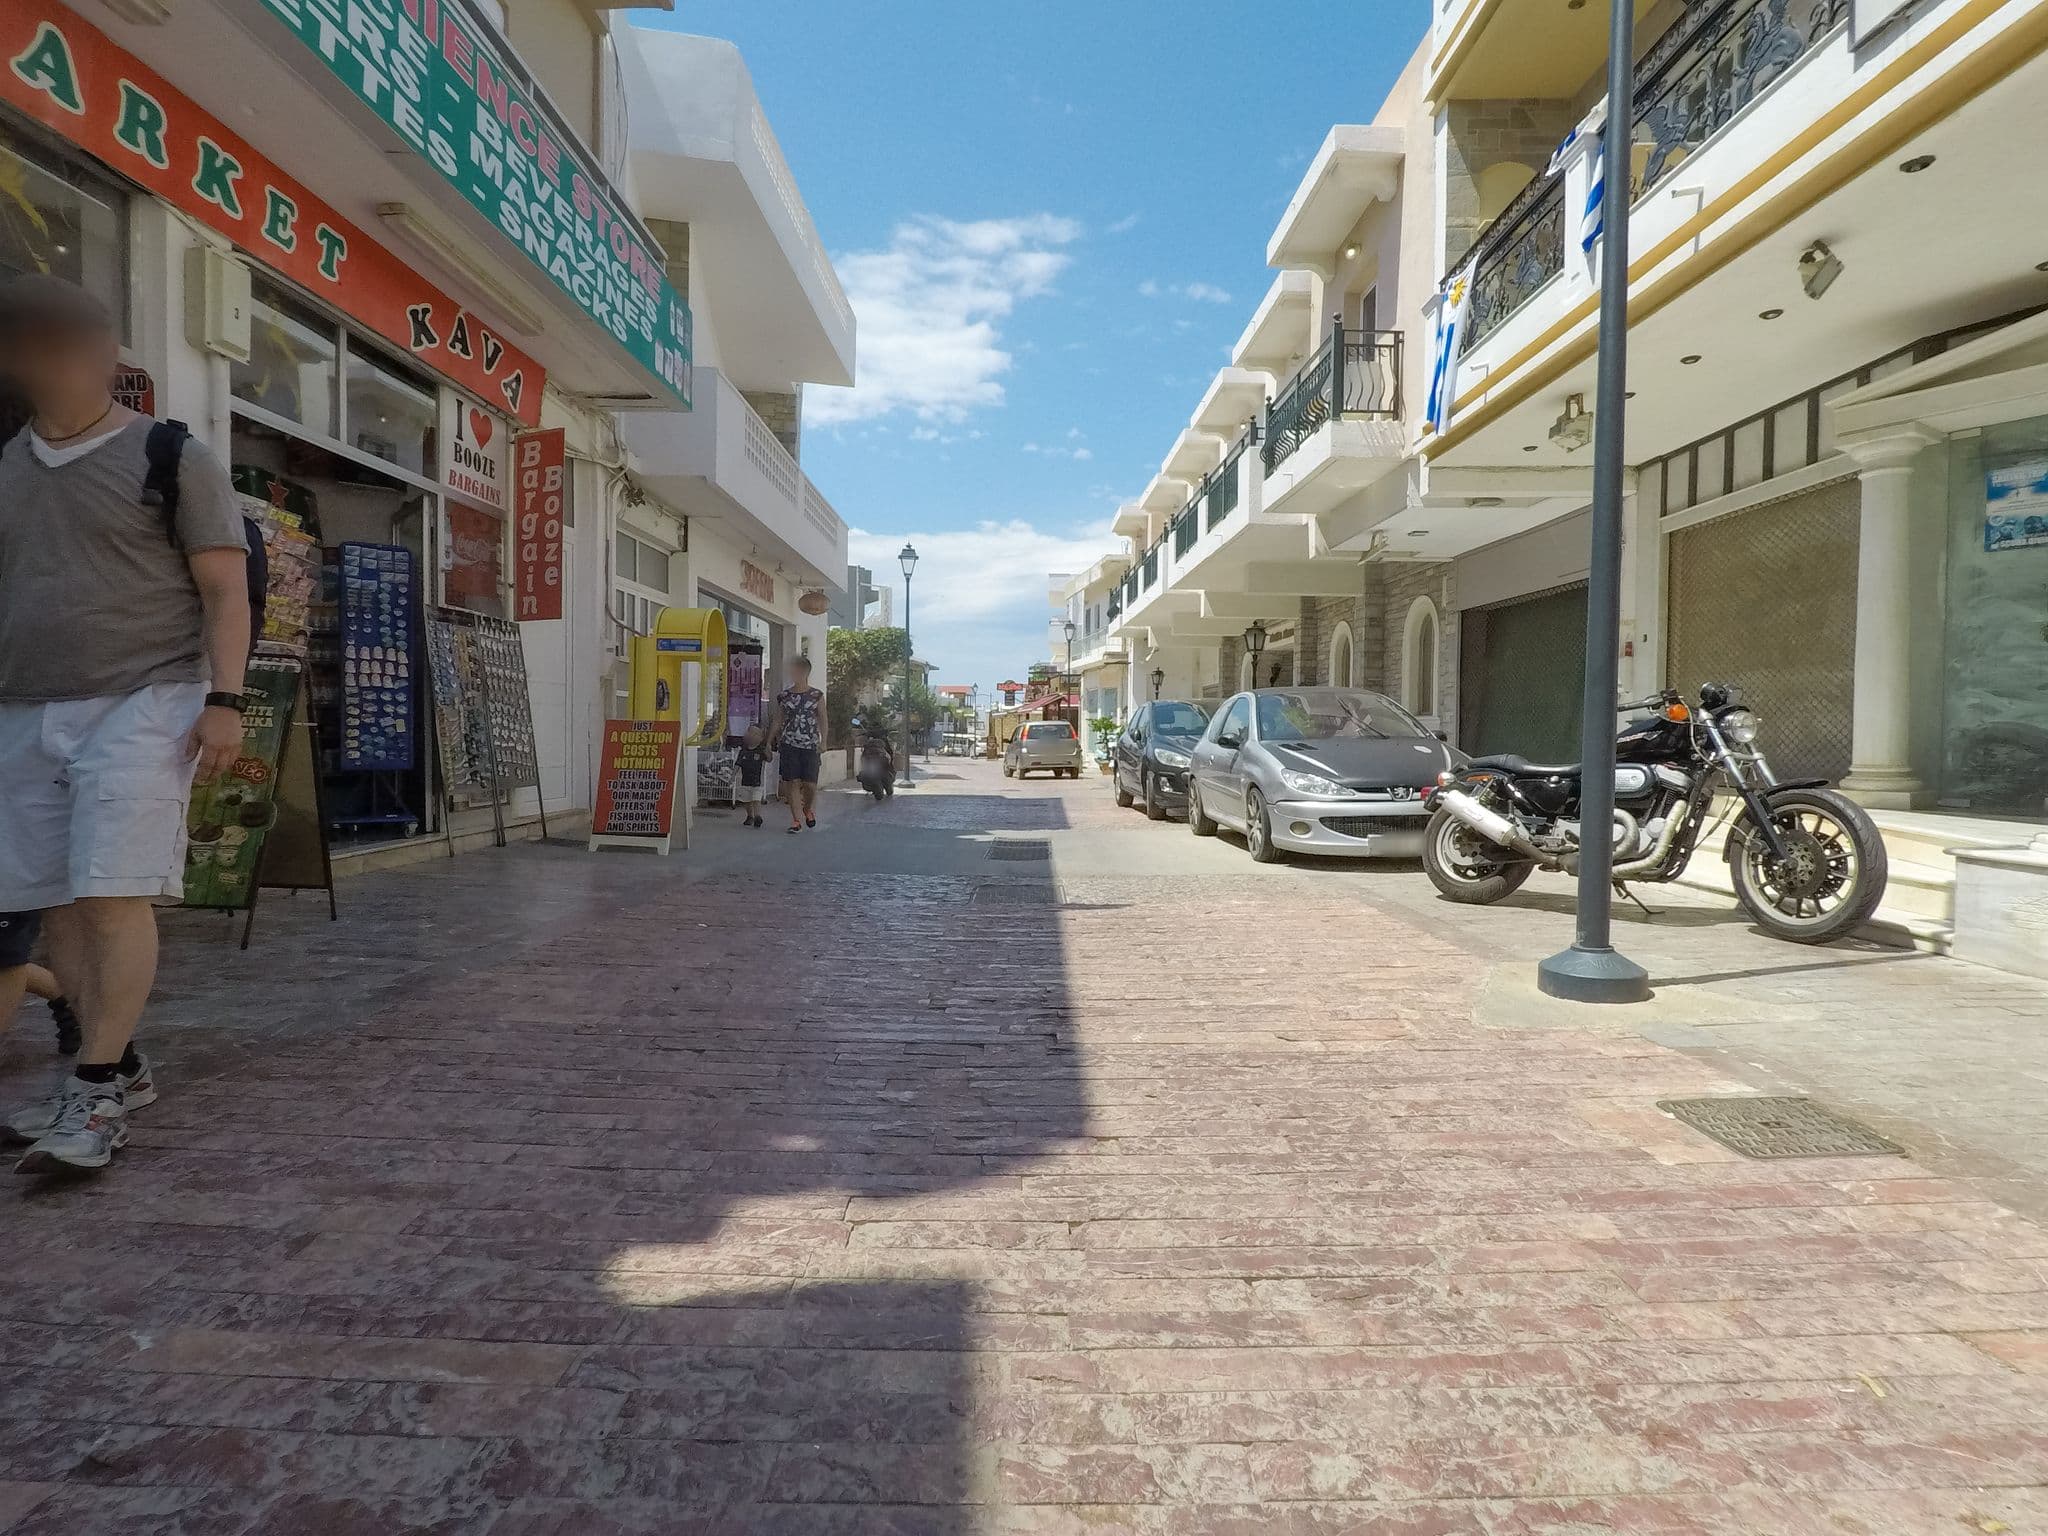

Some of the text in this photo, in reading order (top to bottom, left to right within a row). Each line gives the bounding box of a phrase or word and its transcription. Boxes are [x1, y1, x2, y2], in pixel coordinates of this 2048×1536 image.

[306, 0, 421, 101] RS
[469, 130, 654, 343] MAGAZINES
[9, 21, 524, 414] ARKET KAVA
[476, 102, 658, 324] BEVERAGES
[572, 173, 661, 306] STORE
[499, 201, 629, 343] SNACKS
[454, 398, 465, 441] I
[453, 441, 496, 480] BOOZE
[448, 468, 501, 506] BARGAINS
[521, 440, 542, 616] Bargain
[542, 465, 564, 586] Booze
[610, 731, 673, 744] A QUESTION
[632, 721, 653, 731] JUST
[622, 744, 659, 756] COSTS
[613, 757, 665, 769] NOTHING!
[619, 771, 657, 780] FEEL FREE
[608, 781, 667, 790] TO ASK ABOUT
[612, 791, 660, 801] OUR MAGIC
[609, 812, 659, 821] FISHBOWLS
[614, 801, 656, 811] OFFERS IN
[606, 822, 660, 832] AND SPIRITS
